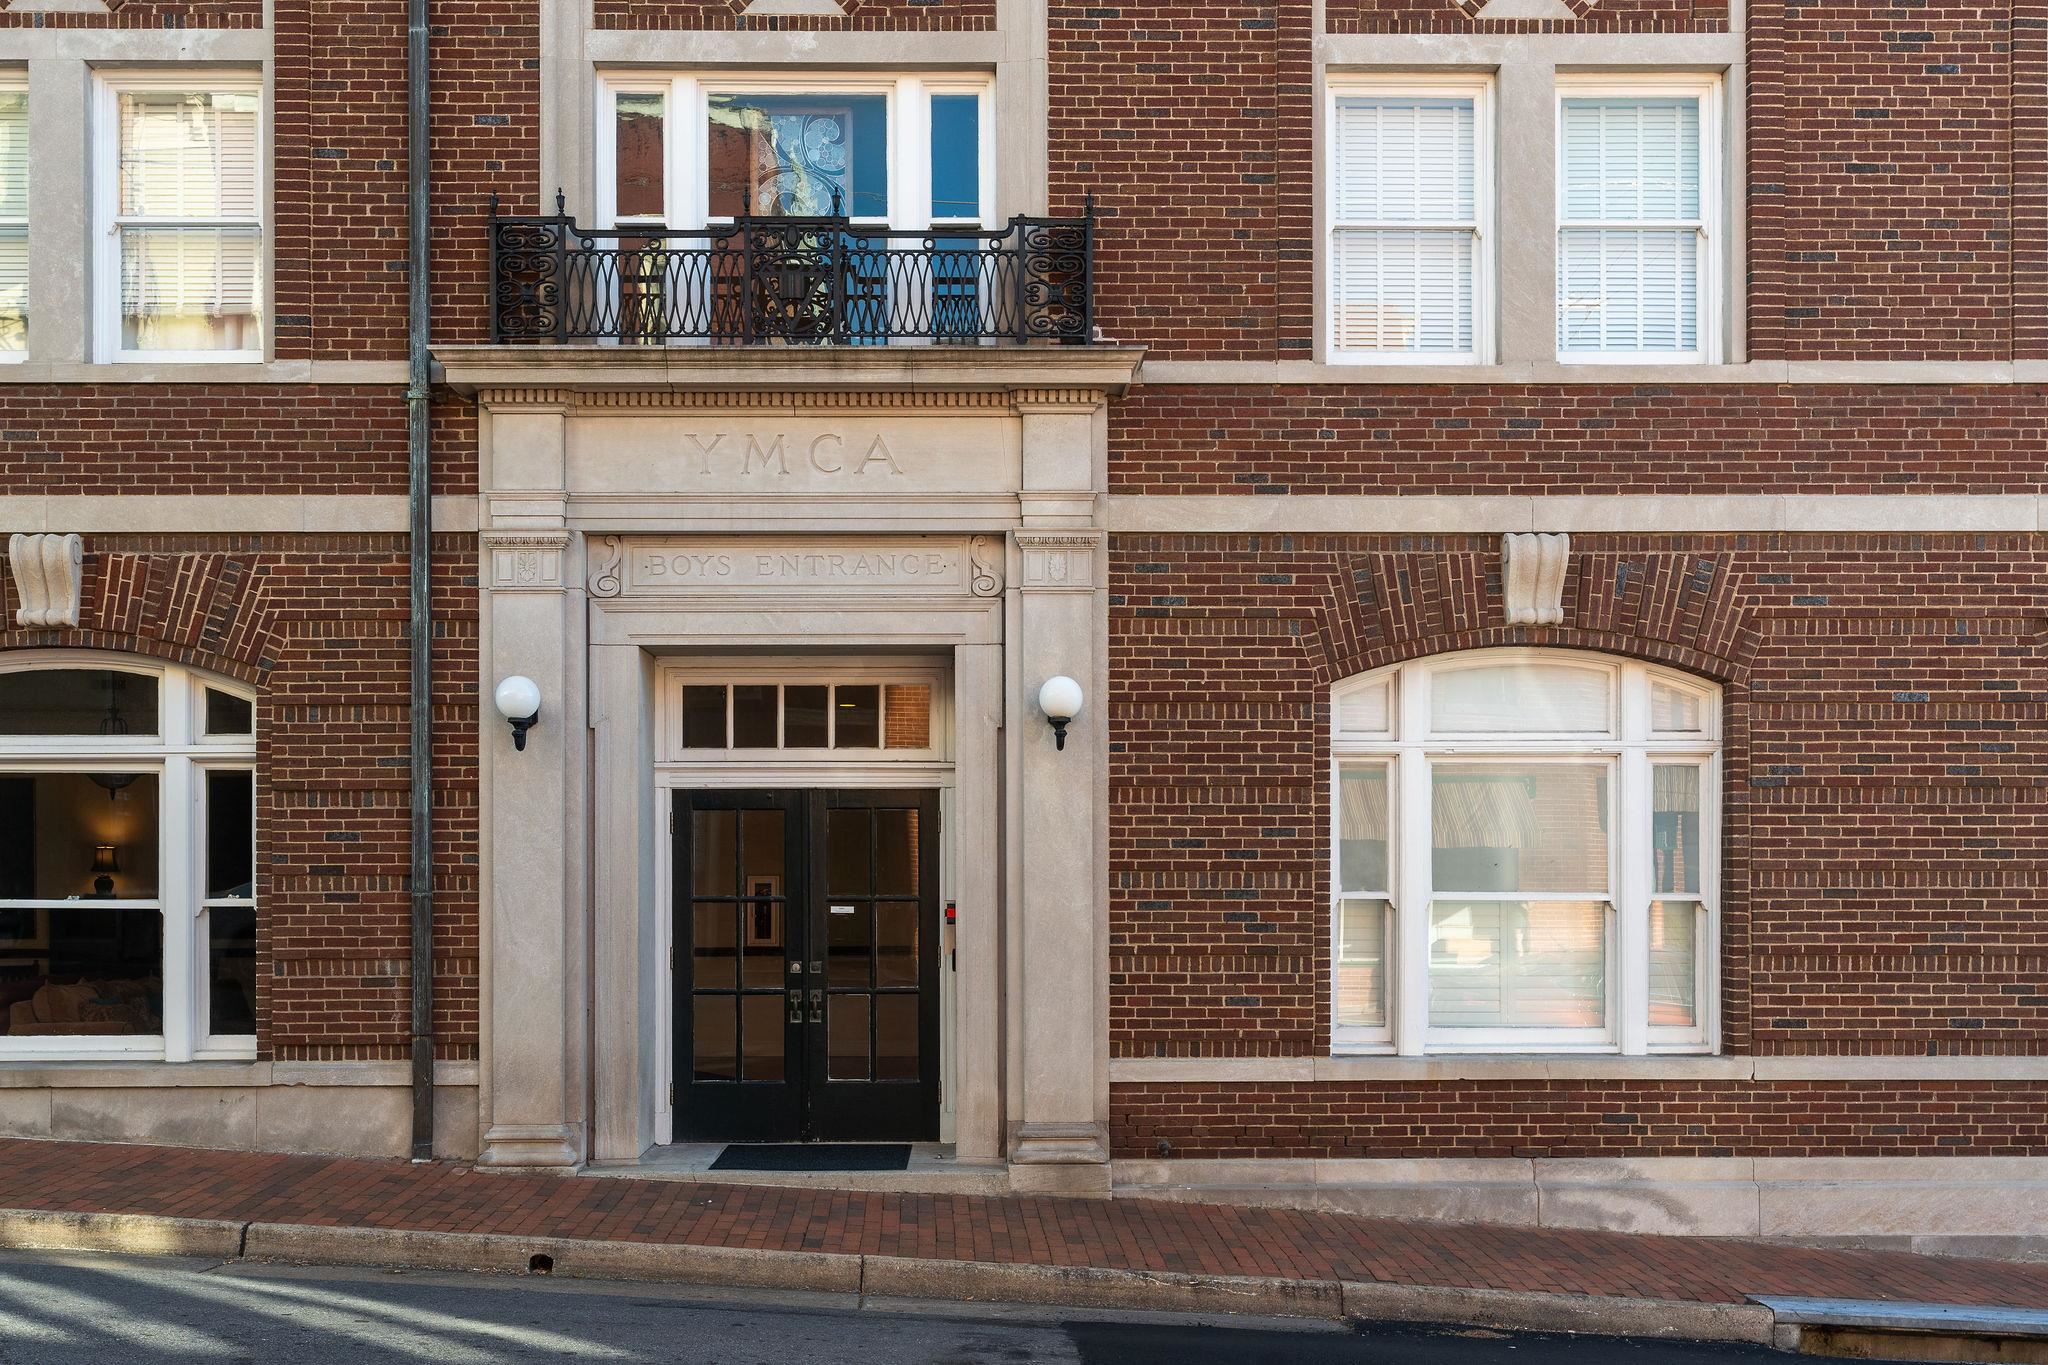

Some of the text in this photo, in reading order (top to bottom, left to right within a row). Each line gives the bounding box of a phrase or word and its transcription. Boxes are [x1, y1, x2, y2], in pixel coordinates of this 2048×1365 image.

[684, 433, 904, 475] YMCA
[649, 553, 945, 577] BOYS ENTRANCE
